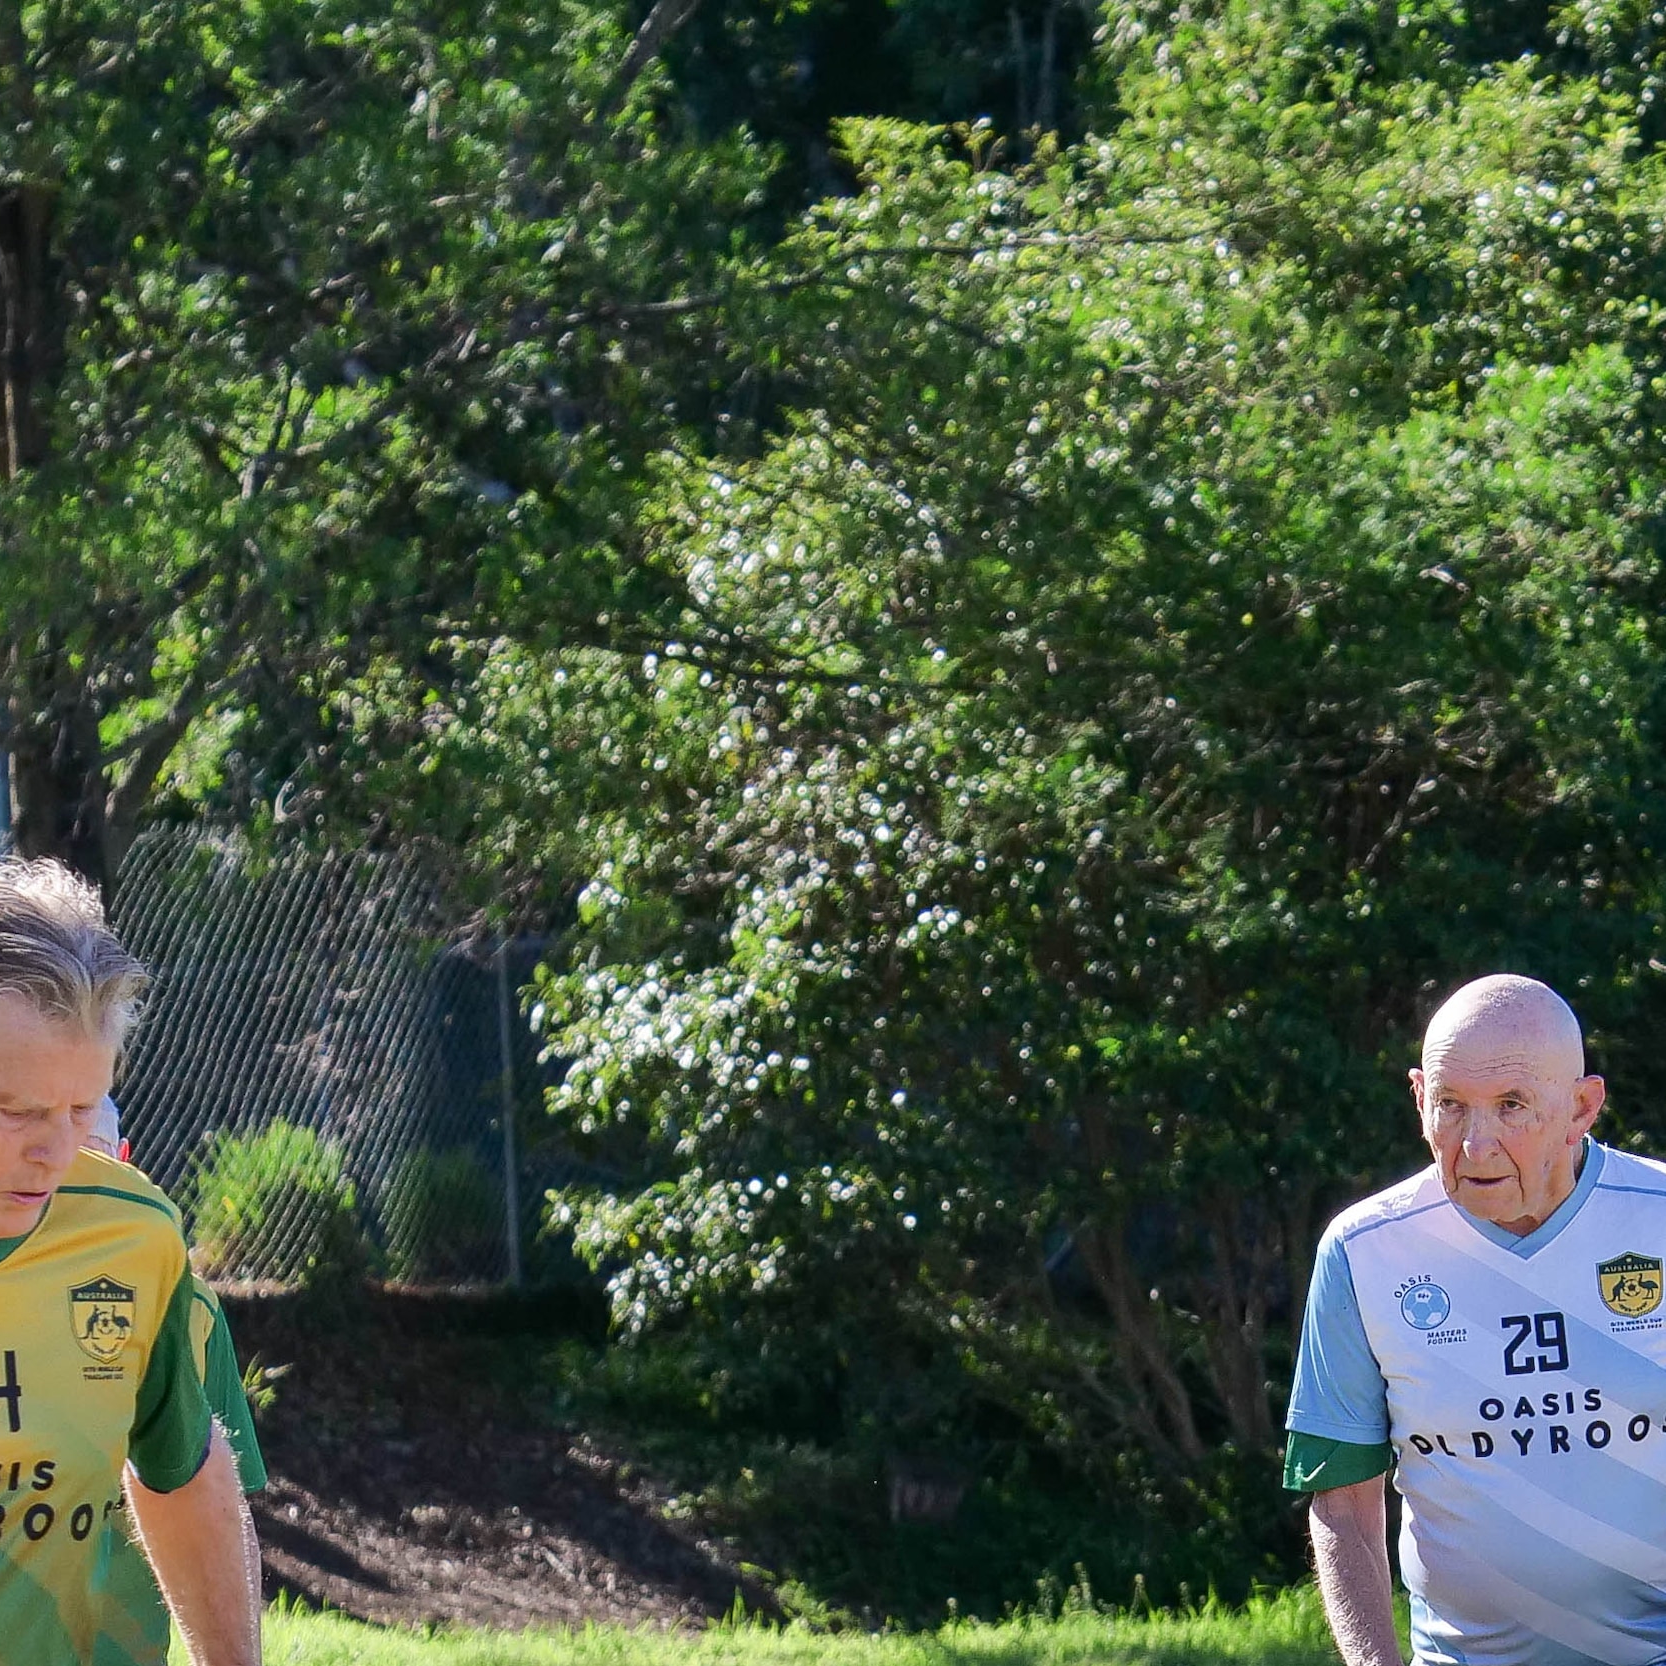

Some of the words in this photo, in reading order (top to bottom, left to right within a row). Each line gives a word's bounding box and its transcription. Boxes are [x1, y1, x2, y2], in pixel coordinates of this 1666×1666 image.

[1604, 1263, 1654, 1272] AUSTRALIA
[1394, 1274, 1431, 1298] OASIS
[1427, 1329, 1467, 1338] MASTERS
[1612, 1325, 1645, 1333] THAILAND
[1427, 1336, 1467, 1345] FOOTBALL
[1501, 1311, 1569, 1376] 29
[1479, 1388, 1602, 1421] OASIS
